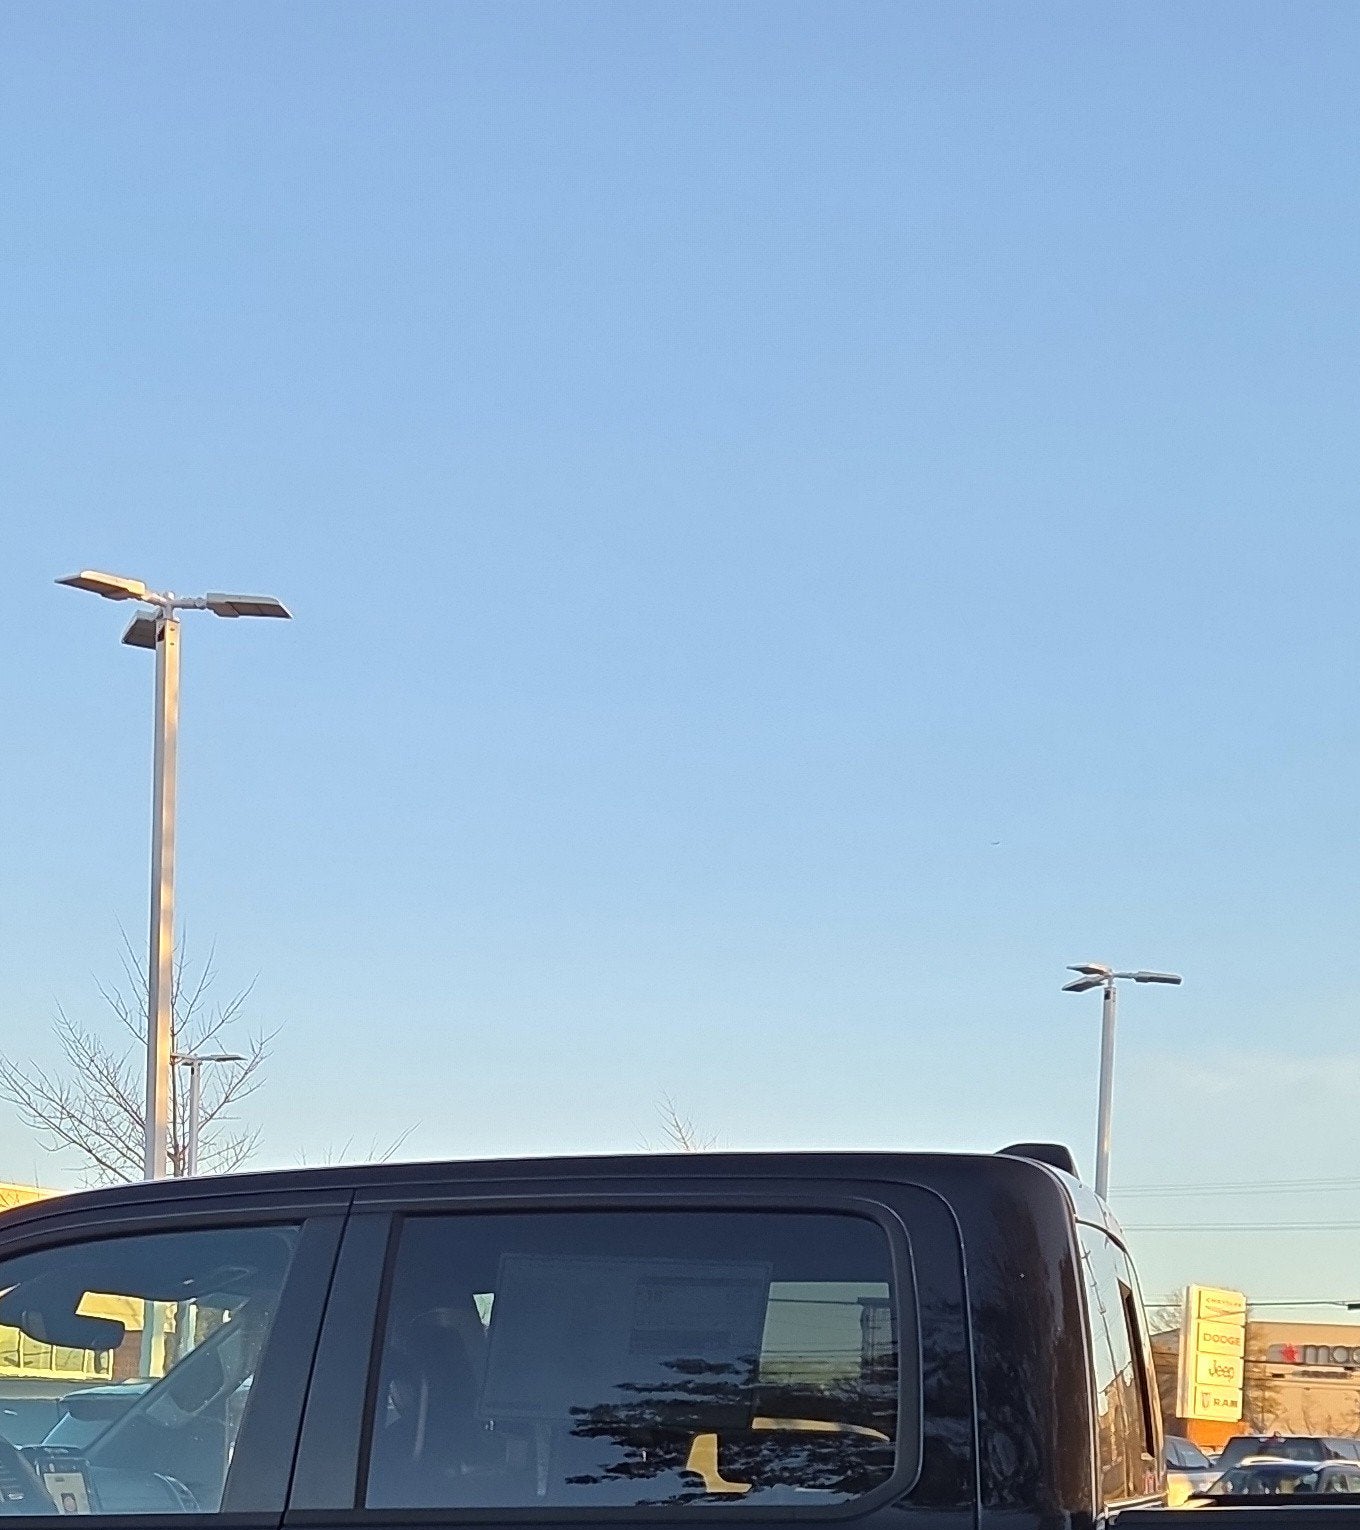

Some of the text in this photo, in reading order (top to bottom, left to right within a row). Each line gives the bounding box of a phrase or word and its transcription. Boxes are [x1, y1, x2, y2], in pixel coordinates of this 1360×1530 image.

[1203, 1332, 1241, 1347] DODGE
[1208, 1359, 1235, 1382] Jeep
[1213, 1398, 1238, 1409] RAM
